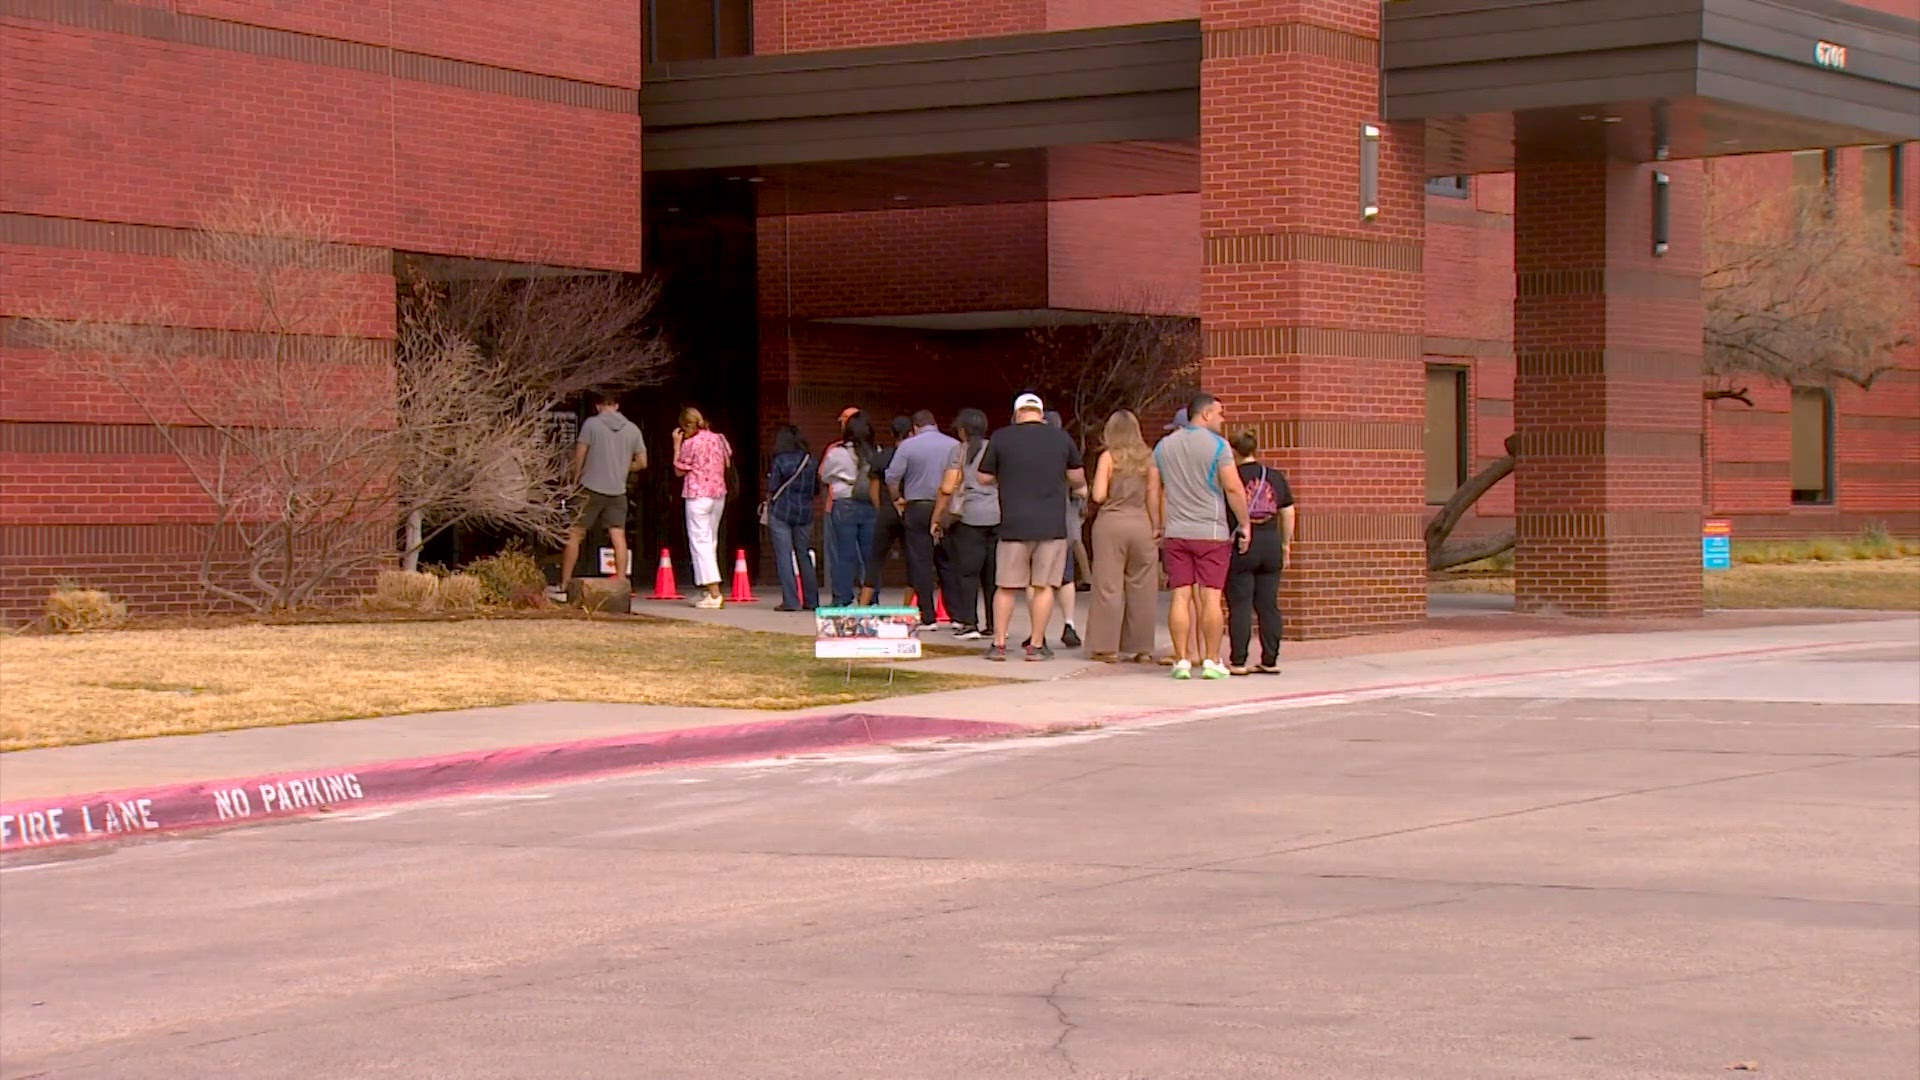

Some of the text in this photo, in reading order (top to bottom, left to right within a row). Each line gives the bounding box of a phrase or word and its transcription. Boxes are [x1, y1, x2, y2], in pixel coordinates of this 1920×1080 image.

[1814, 41, 1847, 68] 6701
[0, 773, 364, 844] FIRE LANE NO PARKING
